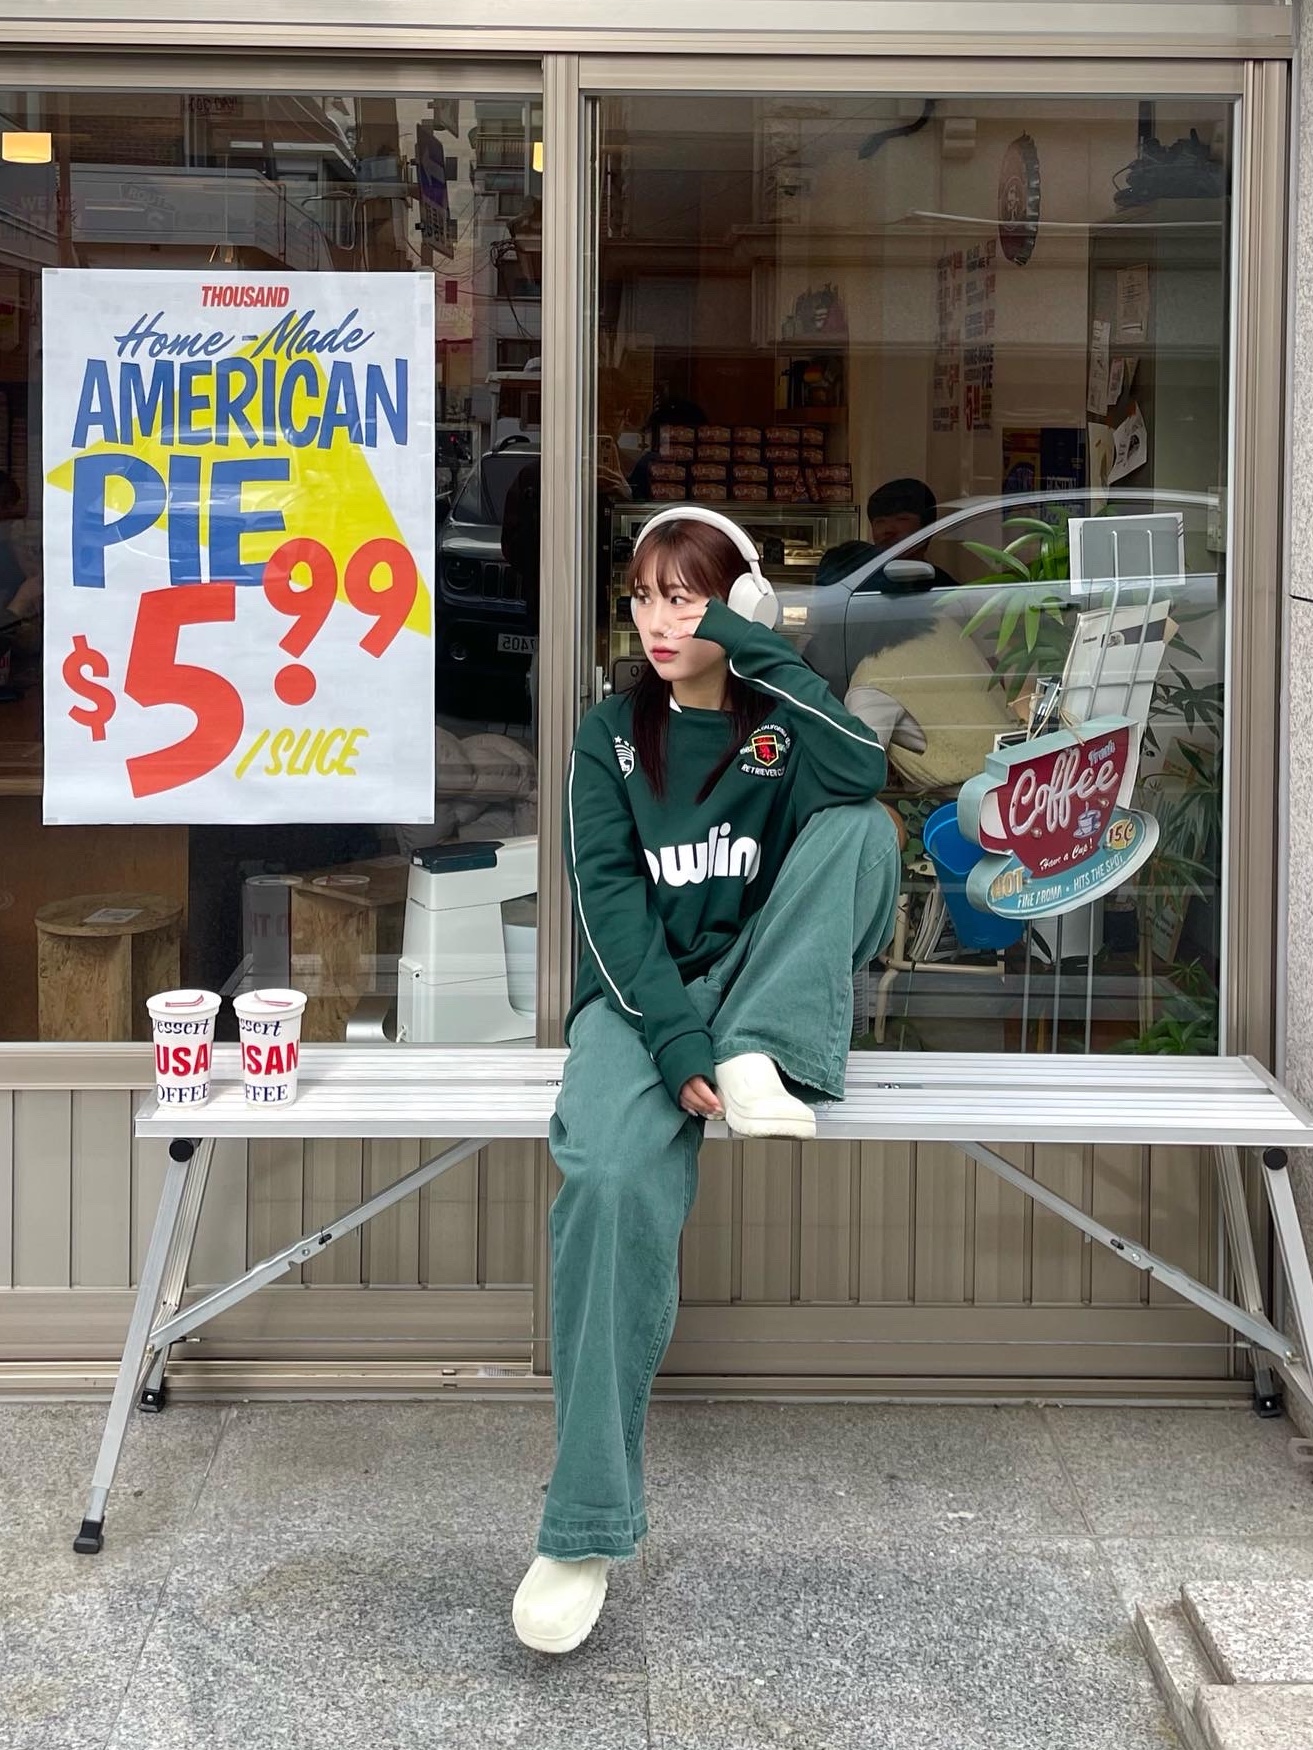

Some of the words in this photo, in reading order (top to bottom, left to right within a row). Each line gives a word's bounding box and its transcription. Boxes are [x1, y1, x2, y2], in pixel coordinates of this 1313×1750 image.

[202, 286, 289, 307] THOUSAND
[72, 357, 408, 450] AMERICAN
[72, 453, 290, 588] PIE
[1008, 747, 1118, 836] Coffee
[644, 822, 761, 887] wlin
[991, 867, 1025, 902] HOT
[1017, 889, 1036, 908] FINE
[1037, 884, 1062, 904] AROMA
[1073, 872, 1091, 891] HITS
[1091, 863, 1105, 882] THE
[153, 1018, 209, 1035] essert
[156, 1041, 213, 1077] USA
